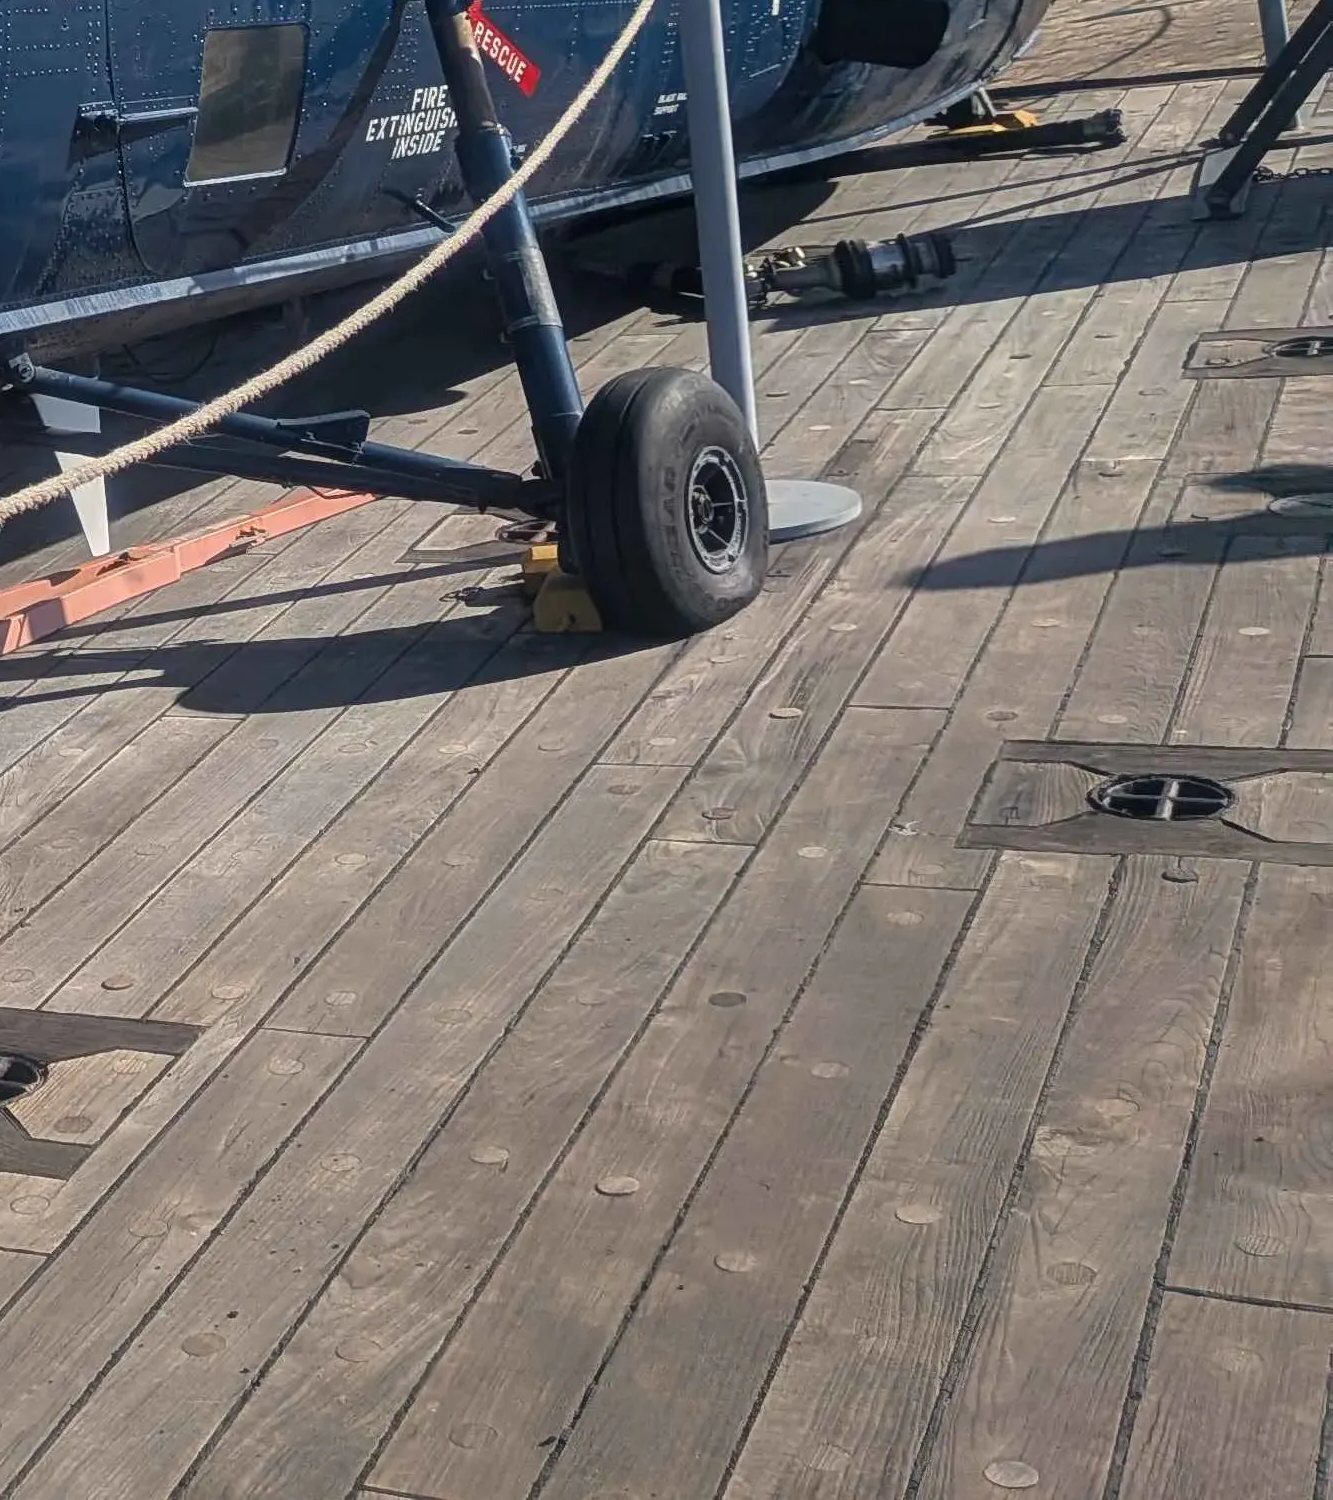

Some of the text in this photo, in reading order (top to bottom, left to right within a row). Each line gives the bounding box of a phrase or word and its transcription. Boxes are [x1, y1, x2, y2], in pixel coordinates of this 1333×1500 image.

[473, 20, 527, 83] RESCUE
[411, 84, 448, 111] FIRE
[391, 130, 445, 160] INSIDE
